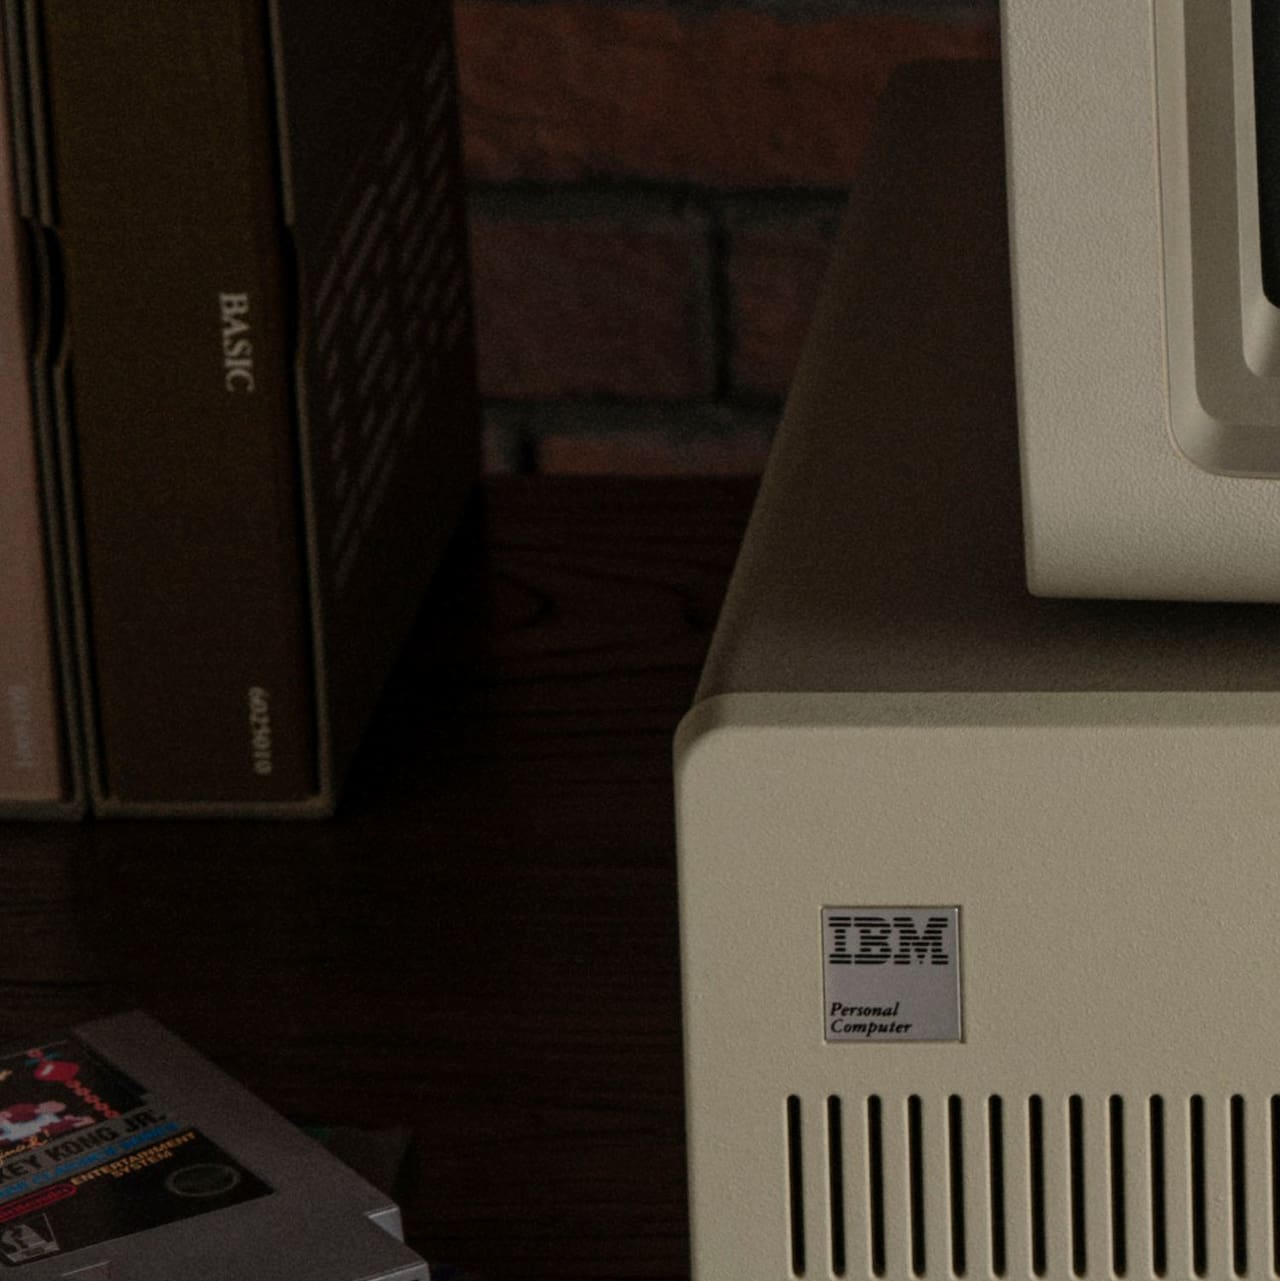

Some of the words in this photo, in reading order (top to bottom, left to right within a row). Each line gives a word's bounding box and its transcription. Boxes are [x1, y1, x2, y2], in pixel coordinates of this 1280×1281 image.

[218, 291, 255, 393] BASIC
[828, 917, 948, 965] IBM
[830, 1002, 900, 1016] Personal
[830, 1018, 913, 1037] Computer
[45, 1126, 119, 1160] KONG
